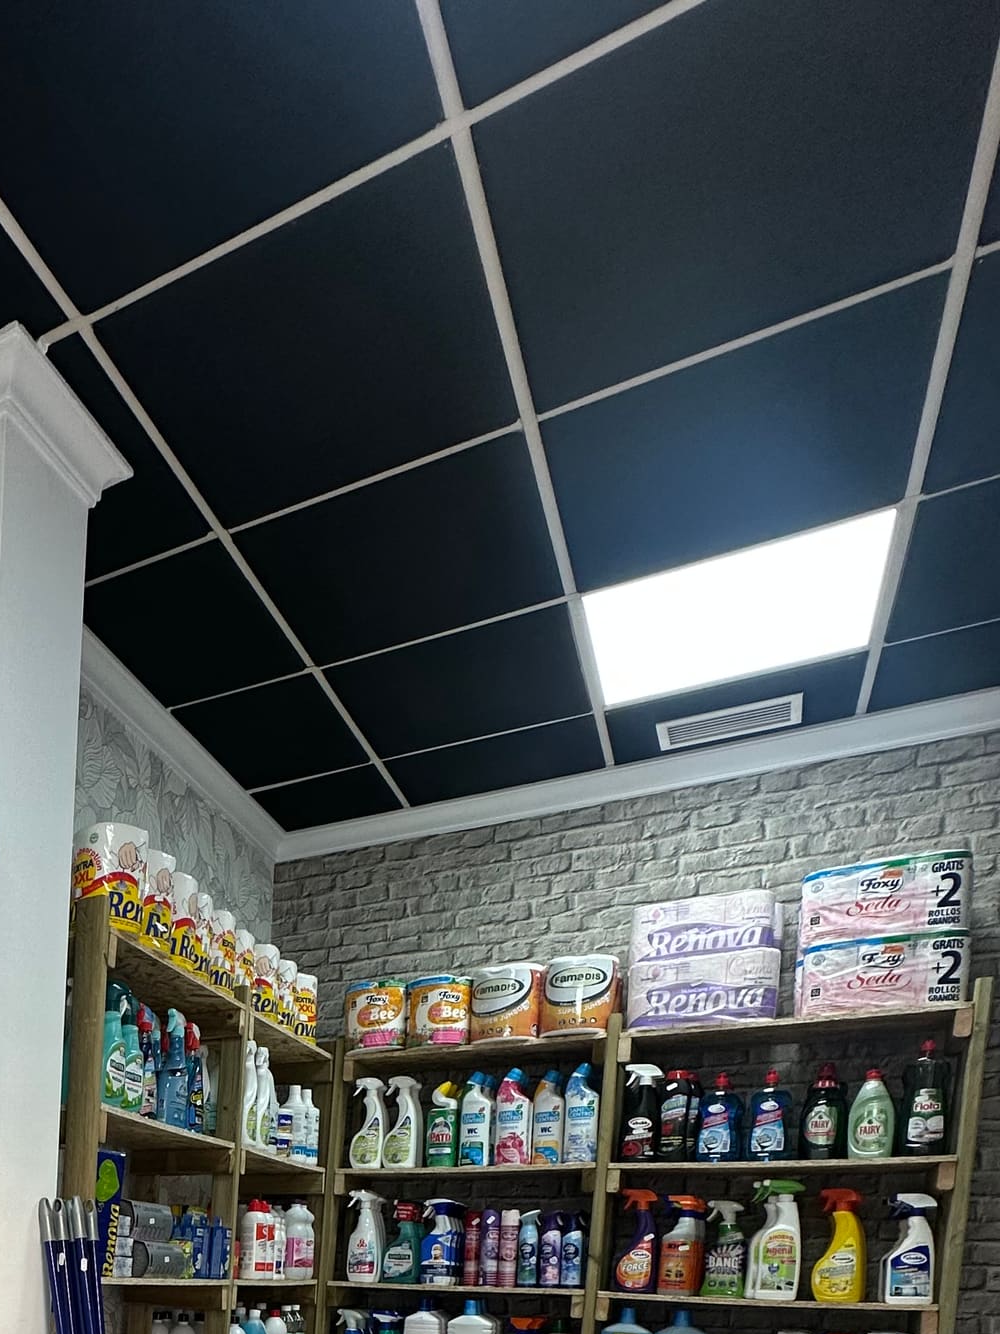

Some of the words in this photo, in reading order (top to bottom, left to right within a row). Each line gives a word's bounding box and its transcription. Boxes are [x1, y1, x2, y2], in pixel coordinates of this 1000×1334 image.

[931, 860, 965, 873] GRATIS
[860, 877, 901, 892] Foxy
[846, 894, 902, 917] Seda
[928, 907, 961, 918] ROLLOS
[927, 916, 961, 926] GRANDES
[648, 925, 763, 958] Renova
[932, 938, 965, 950] GRATIS
[846, 969, 902, 990] Seda
[928, 985, 961, 994] ROLLOS
[646, 987, 765, 1017] Renova
[927, 993, 960, 1002] GRANDES
[370, 1008, 395, 1020] Bee
[442, 1005, 466, 1019] Bee
[914, 1102, 940, 1111] Flota
[540, 1126, 552, 1134] WC
[810, 1119, 830, 1129] FAIRY
[859, 1124, 881, 1136] FAIRY
[466, 1127, 479, 1135] WC
[101, 1203, 121, 1278] Renova
[708, 1256, 740, 1269] BANG
